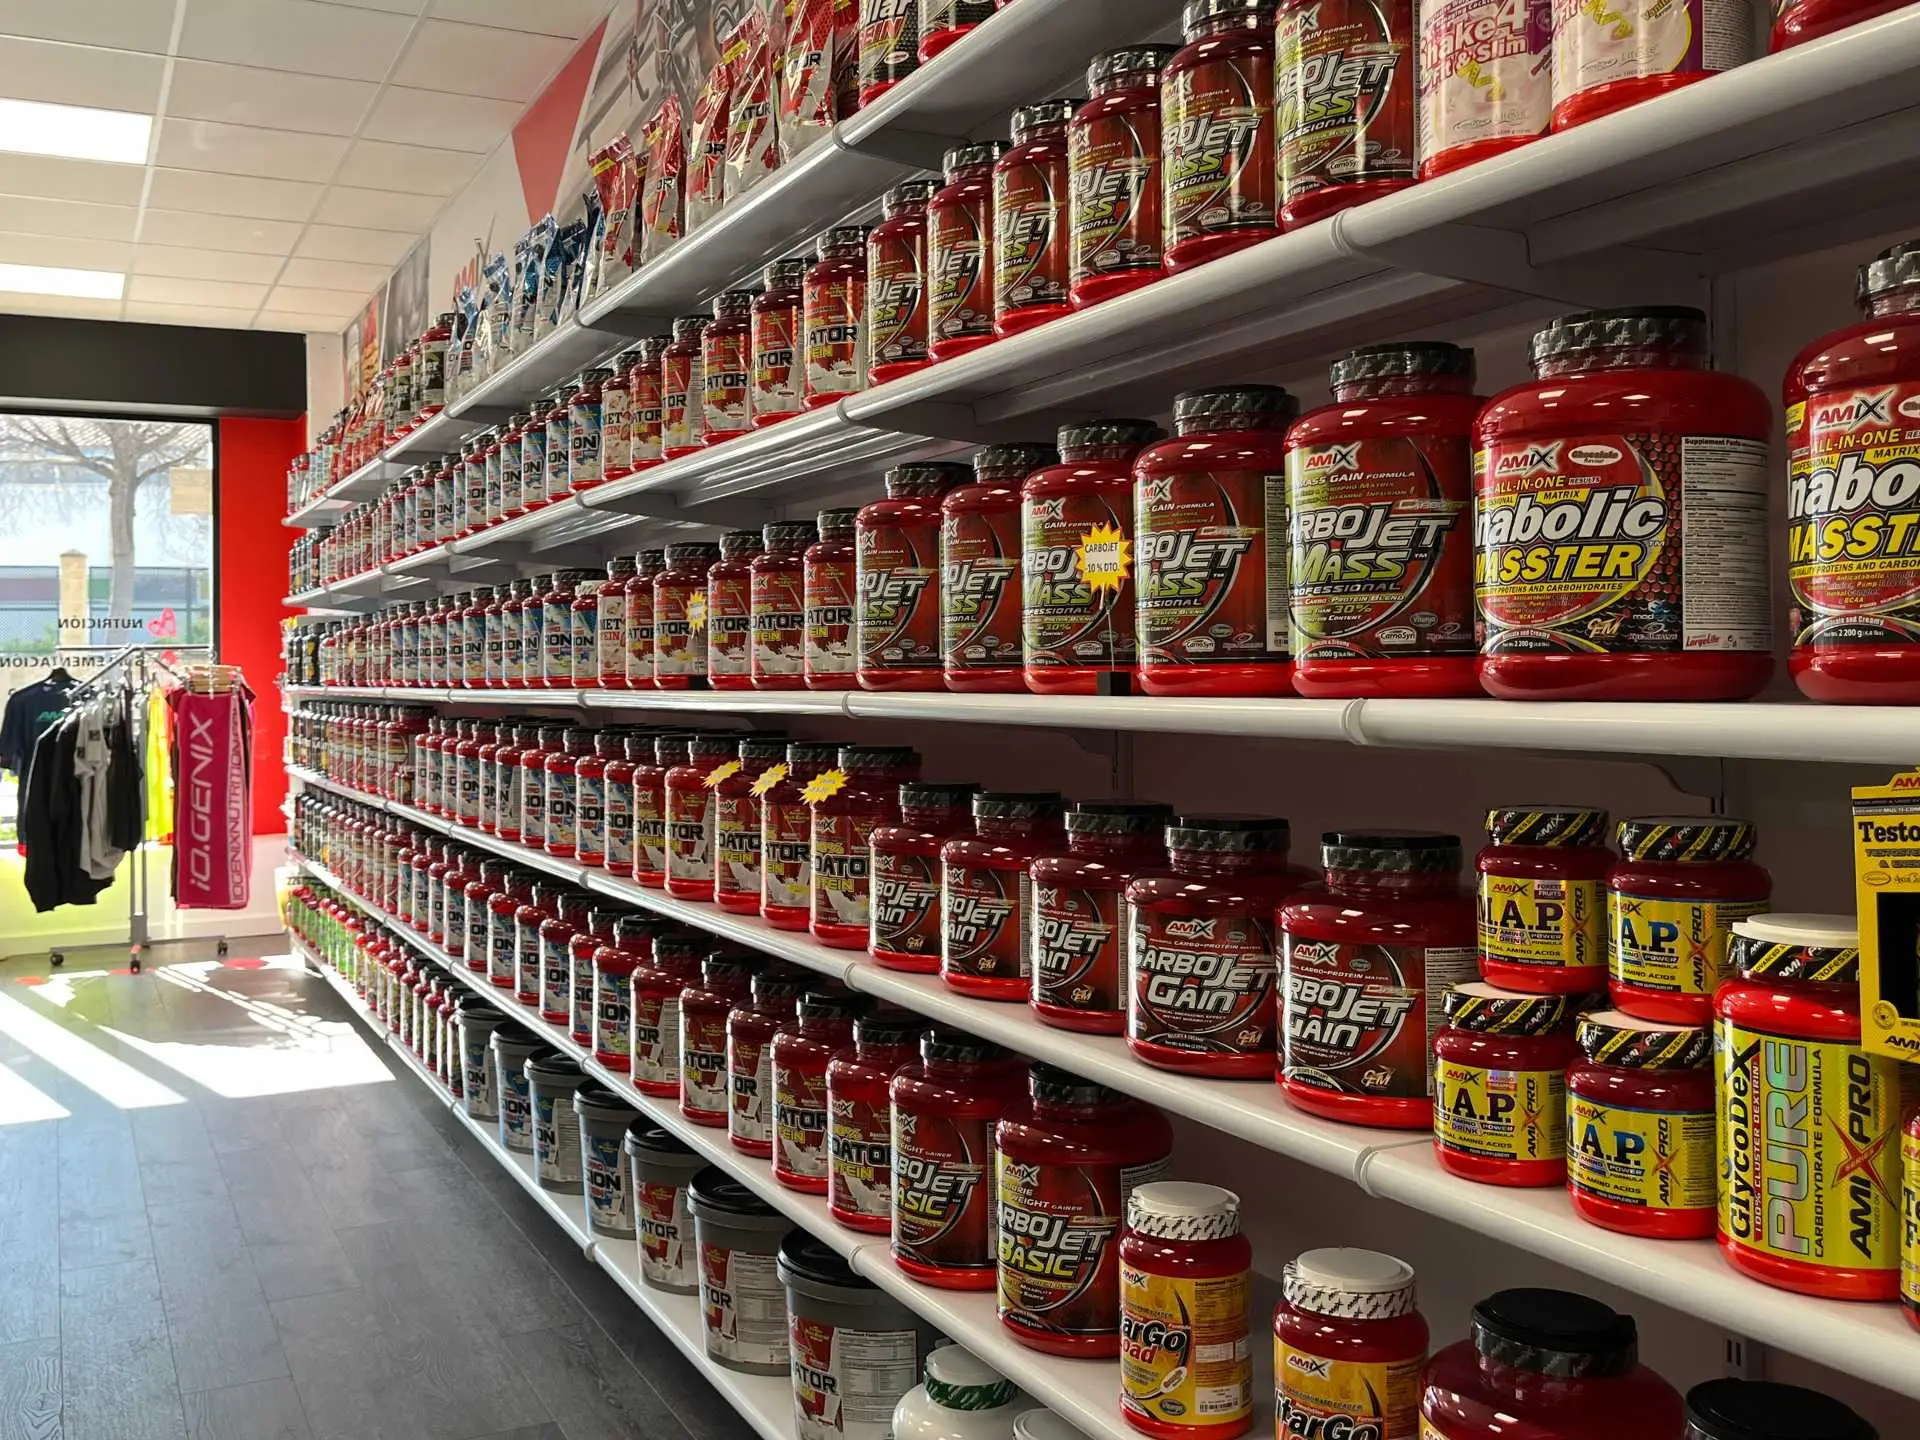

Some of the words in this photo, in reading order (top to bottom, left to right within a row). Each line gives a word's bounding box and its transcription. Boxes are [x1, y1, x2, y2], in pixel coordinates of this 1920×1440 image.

[1816, 388, 1896, 431] AMIX
[1306, 441, 1362, 472] AMIX
[1499, 442, 1562, 473] AMIX
[1329, 471, 1364, 484] GAIN
[1495, 476, 1567, 493] ALL-IN-ONE
[1543, 489, 1582, 500] MATRIX
[1856, 561, 1877, 571] AND
[1547, 582, 1624, 592] CARBOHYDRATES
[1493, 881, 1533, 898] AMIX
[1168, 919, 1217, 940] AMIX
[1295, 943, 1340, 966] AMIX
[1644, 954, 1679, 963] POWER
[1648, 972, 1677, 981] ACIDS
[1147, 974, 1238, 1015] GAIN
[1446, 1068, 1483, 1086] AMIX
[1812, 1048, 1823, 1127] FORMULA
[1576, 1105, 1610, 1124] AMIX
[1486, 1141, 1513, 1149] ACIDS
[1724, 1037, 1761, 1239] GlycoDeX
[1764, 1039, 1810, 1256] PURE
[1752, 1128, 1762, 1188] CLUSTER
[1006, 1164, 1041, 1187] AMIX
[1613, 1184, 1642, 1194] ACIDS
[1813, 1131, 1825, 1259] CARBOHYDRATE
[1288, 1353, 1332, 1379] AMIX
